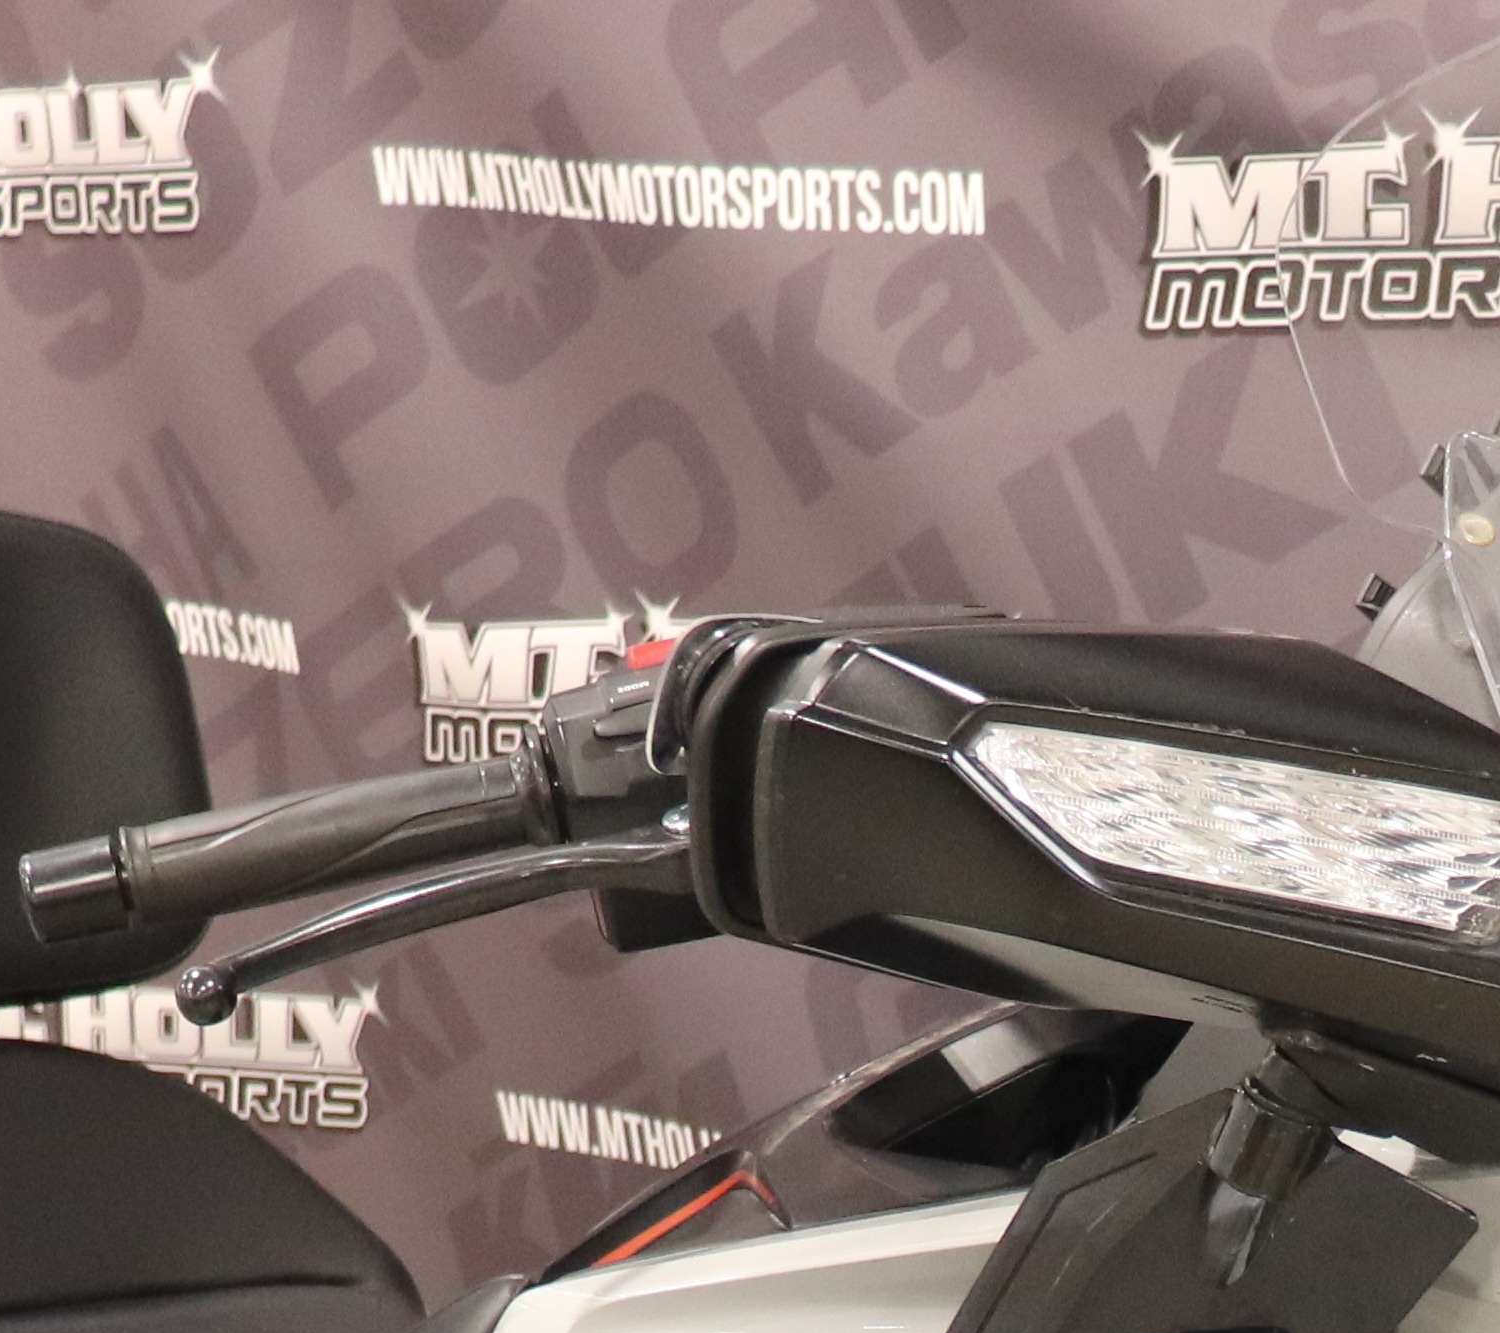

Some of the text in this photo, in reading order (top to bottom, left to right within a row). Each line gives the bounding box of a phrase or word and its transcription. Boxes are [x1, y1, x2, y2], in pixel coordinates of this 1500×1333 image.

[373, 144, 986, 238] WWW.MTHOLLYMOTORSPORTS.COM
[1152, 142, 1410, 258] MT.
[420, 618, 626, 707] MT
